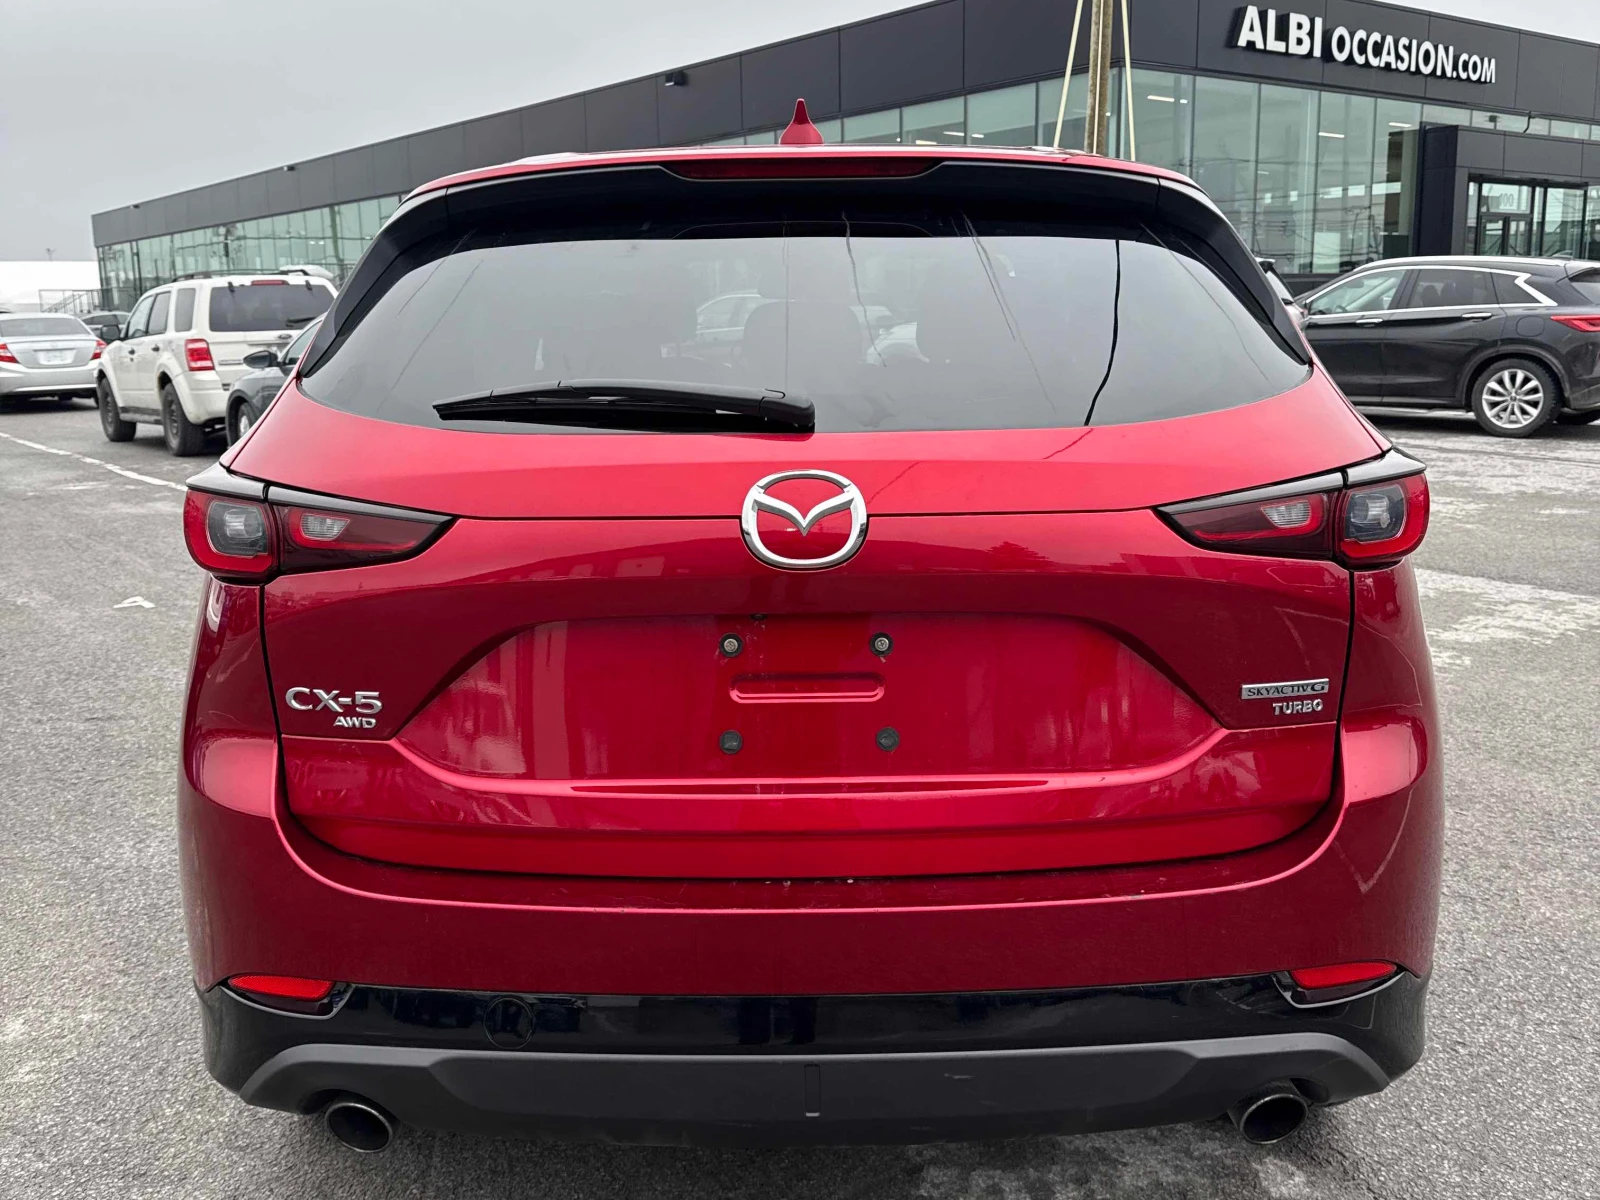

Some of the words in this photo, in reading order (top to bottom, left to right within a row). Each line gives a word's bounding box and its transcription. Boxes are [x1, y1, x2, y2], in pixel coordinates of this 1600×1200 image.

[1237, 4, 1323, 58] ALBI
[285, 686, 383, 715] CX-5
[1272, 698, 1324, 716] TURBO
[333, 715, 377, 729] AWD
